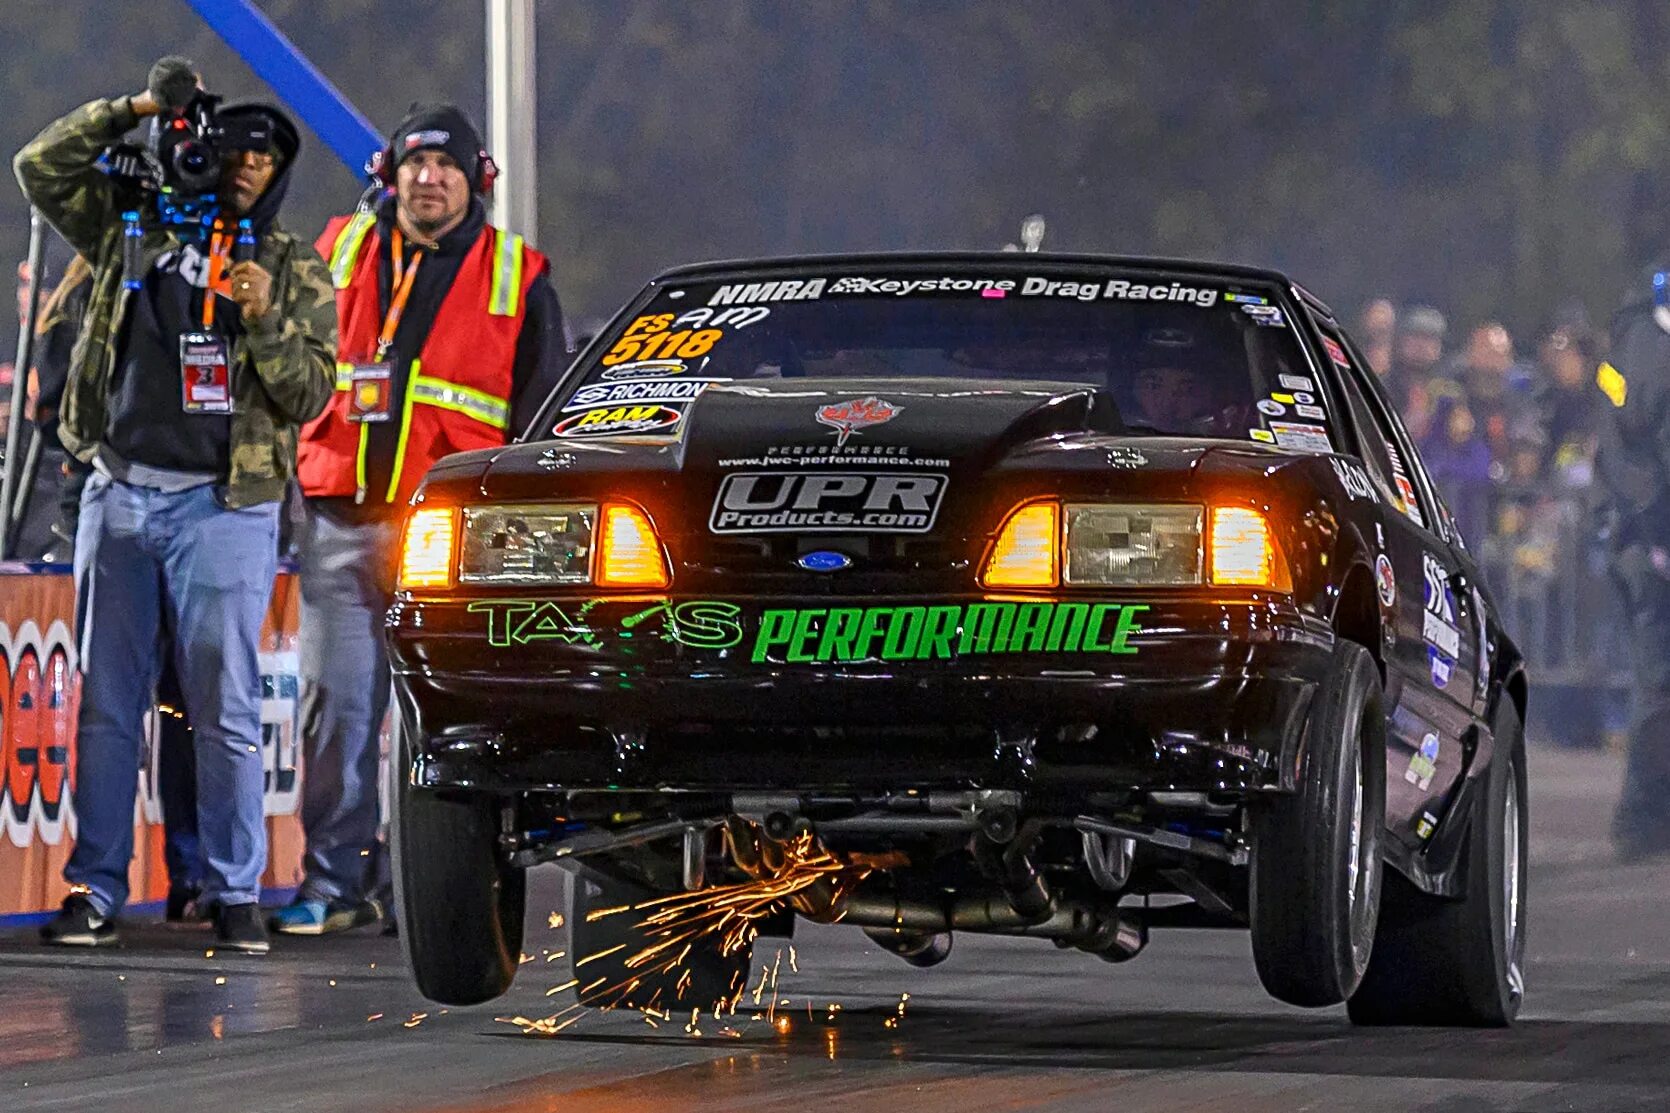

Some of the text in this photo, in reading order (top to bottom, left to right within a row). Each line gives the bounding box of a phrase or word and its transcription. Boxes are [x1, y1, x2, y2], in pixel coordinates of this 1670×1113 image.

[707, 278, 827, 306] NMRA
[857, 277, 1016, 295] Keystone
[1021, 277, 1100, 301] Drag
[1103, 280, 1218, 307] Racing
[602, 329, 723, 366] 5118
[606, 382, 709, 401] RICHMON
[577, 404, 662, 427] RAM
[717, 454, 951, 468] www.jwc-performance.com
[722, 475, 939, 511] UPR
[716, 510, 928, 528] Products.com
[752, 603, 1151, 663] PERFORMANCE
